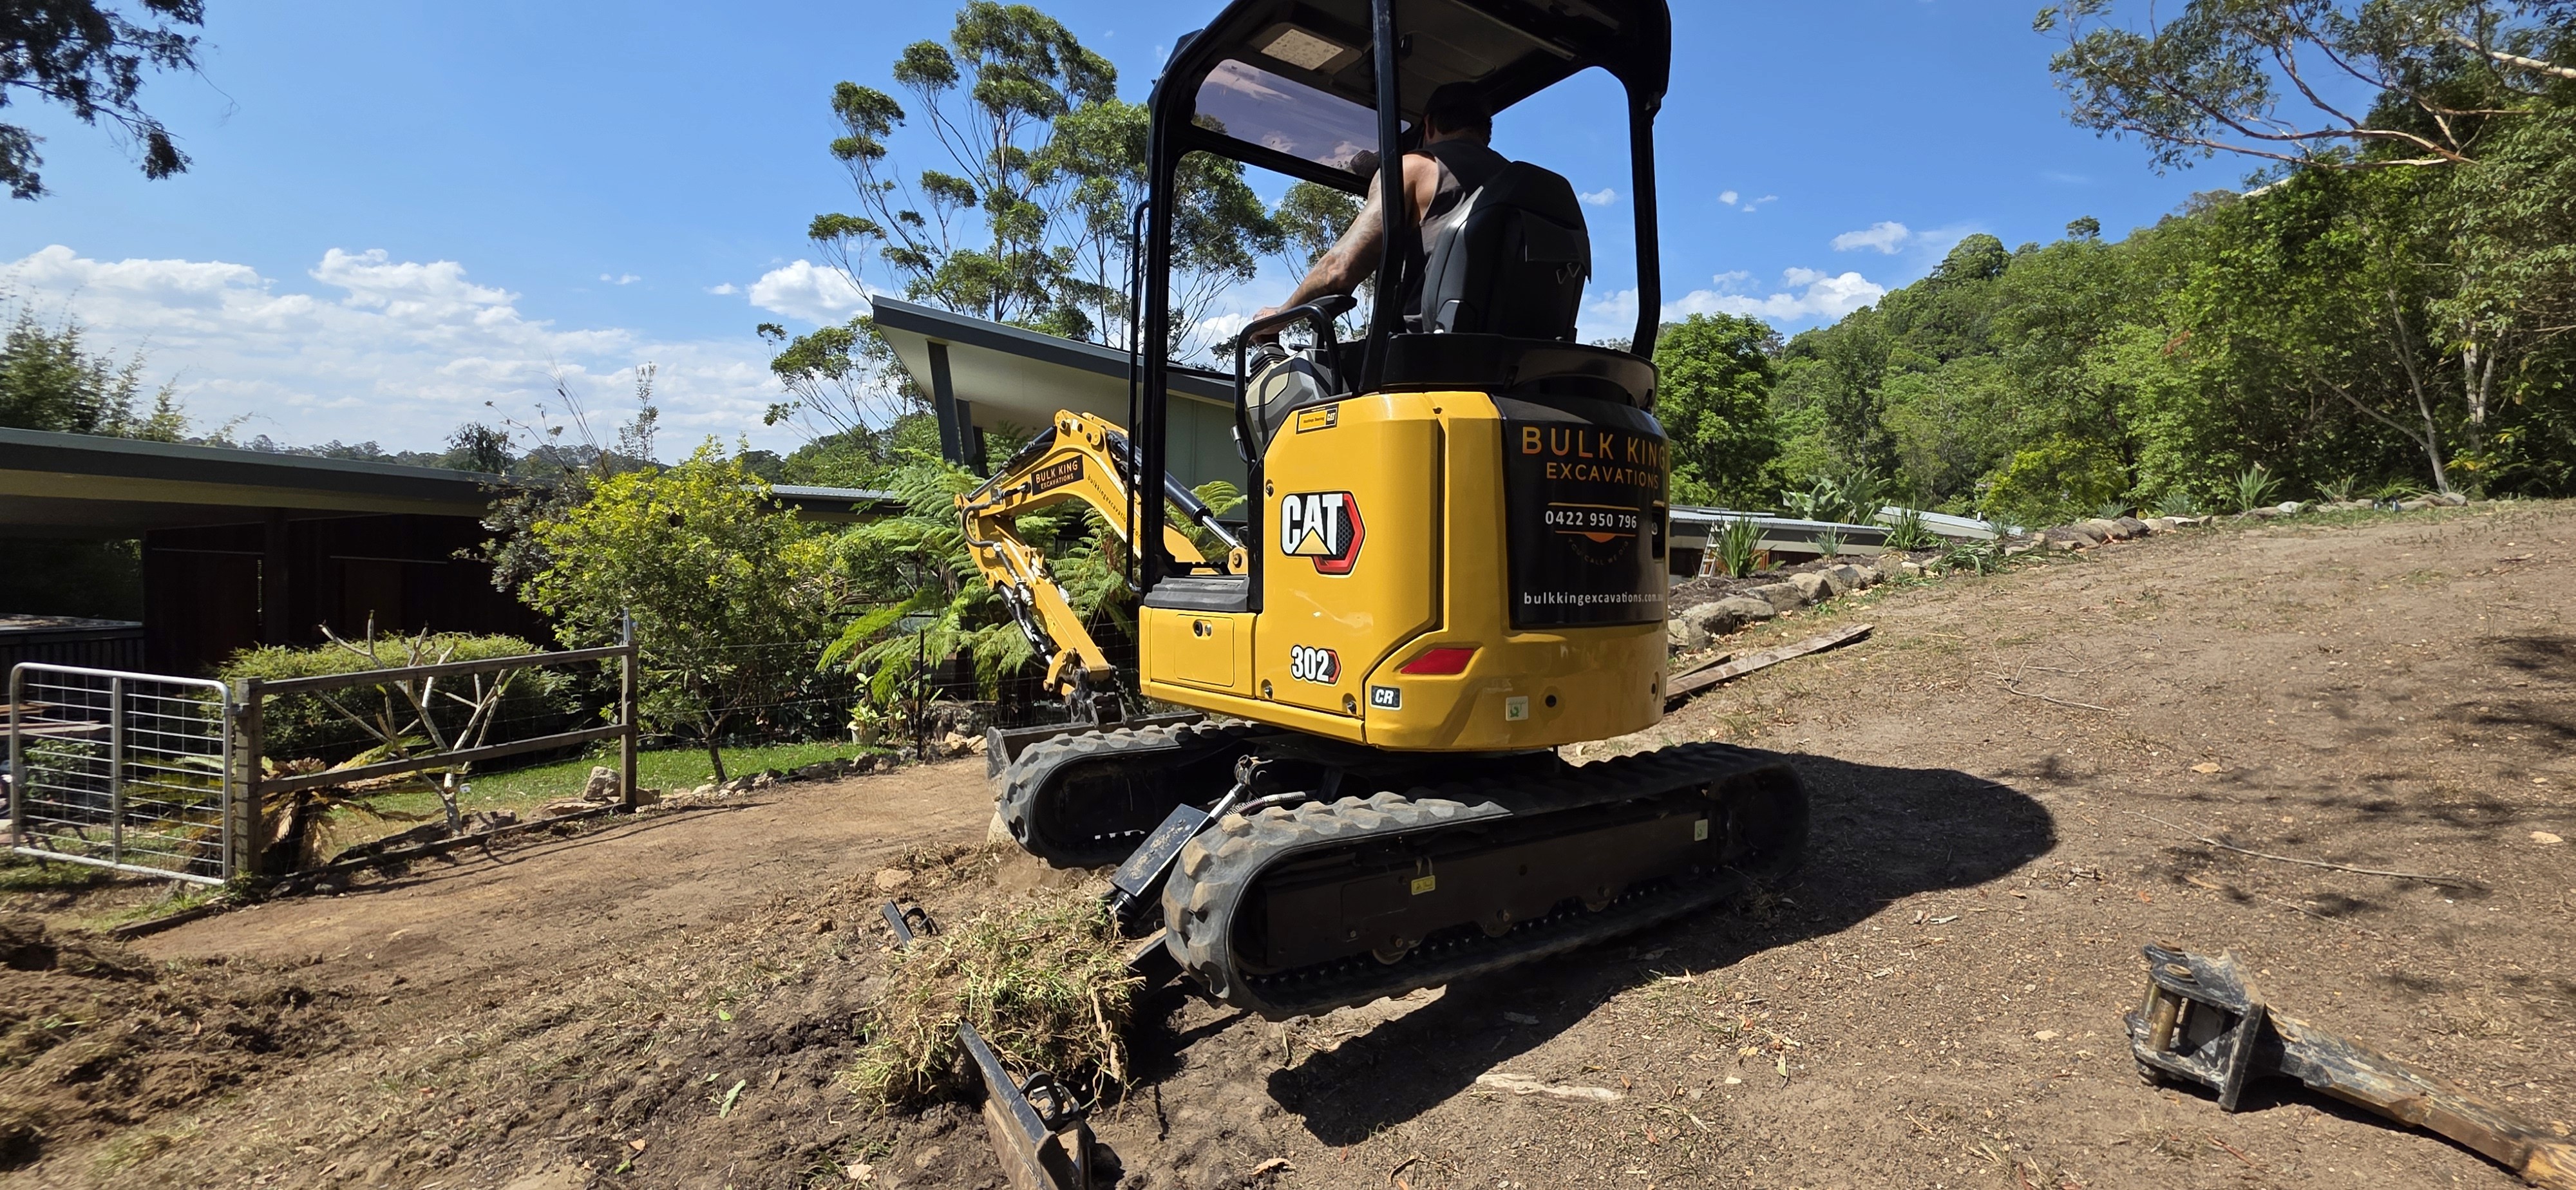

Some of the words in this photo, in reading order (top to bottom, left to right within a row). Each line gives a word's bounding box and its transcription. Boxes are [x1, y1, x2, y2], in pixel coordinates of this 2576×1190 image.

[1522, 426, 1615, 460] BULK
[1627, 436, 1665, 471] KING
[1036, 468, 1056, 484] BULK
[1058, 460, 1078, 476] KING
[1040, 473, 1074, 490] EXCAVATIONS
[1546, 462, 1660, 490] EXCAVATIONS
[1282, 493, 1343, 556] CAT
[1545, 510, 1584, 525] 0422
[1589, 513, 1614, 527] 950
[1618, 514, 1637, 529] 796
[1584, 554, 1604, 565] CALL
[1291, 645, 1329, 683] 302
[1374, 688, 1394, 705] CR
